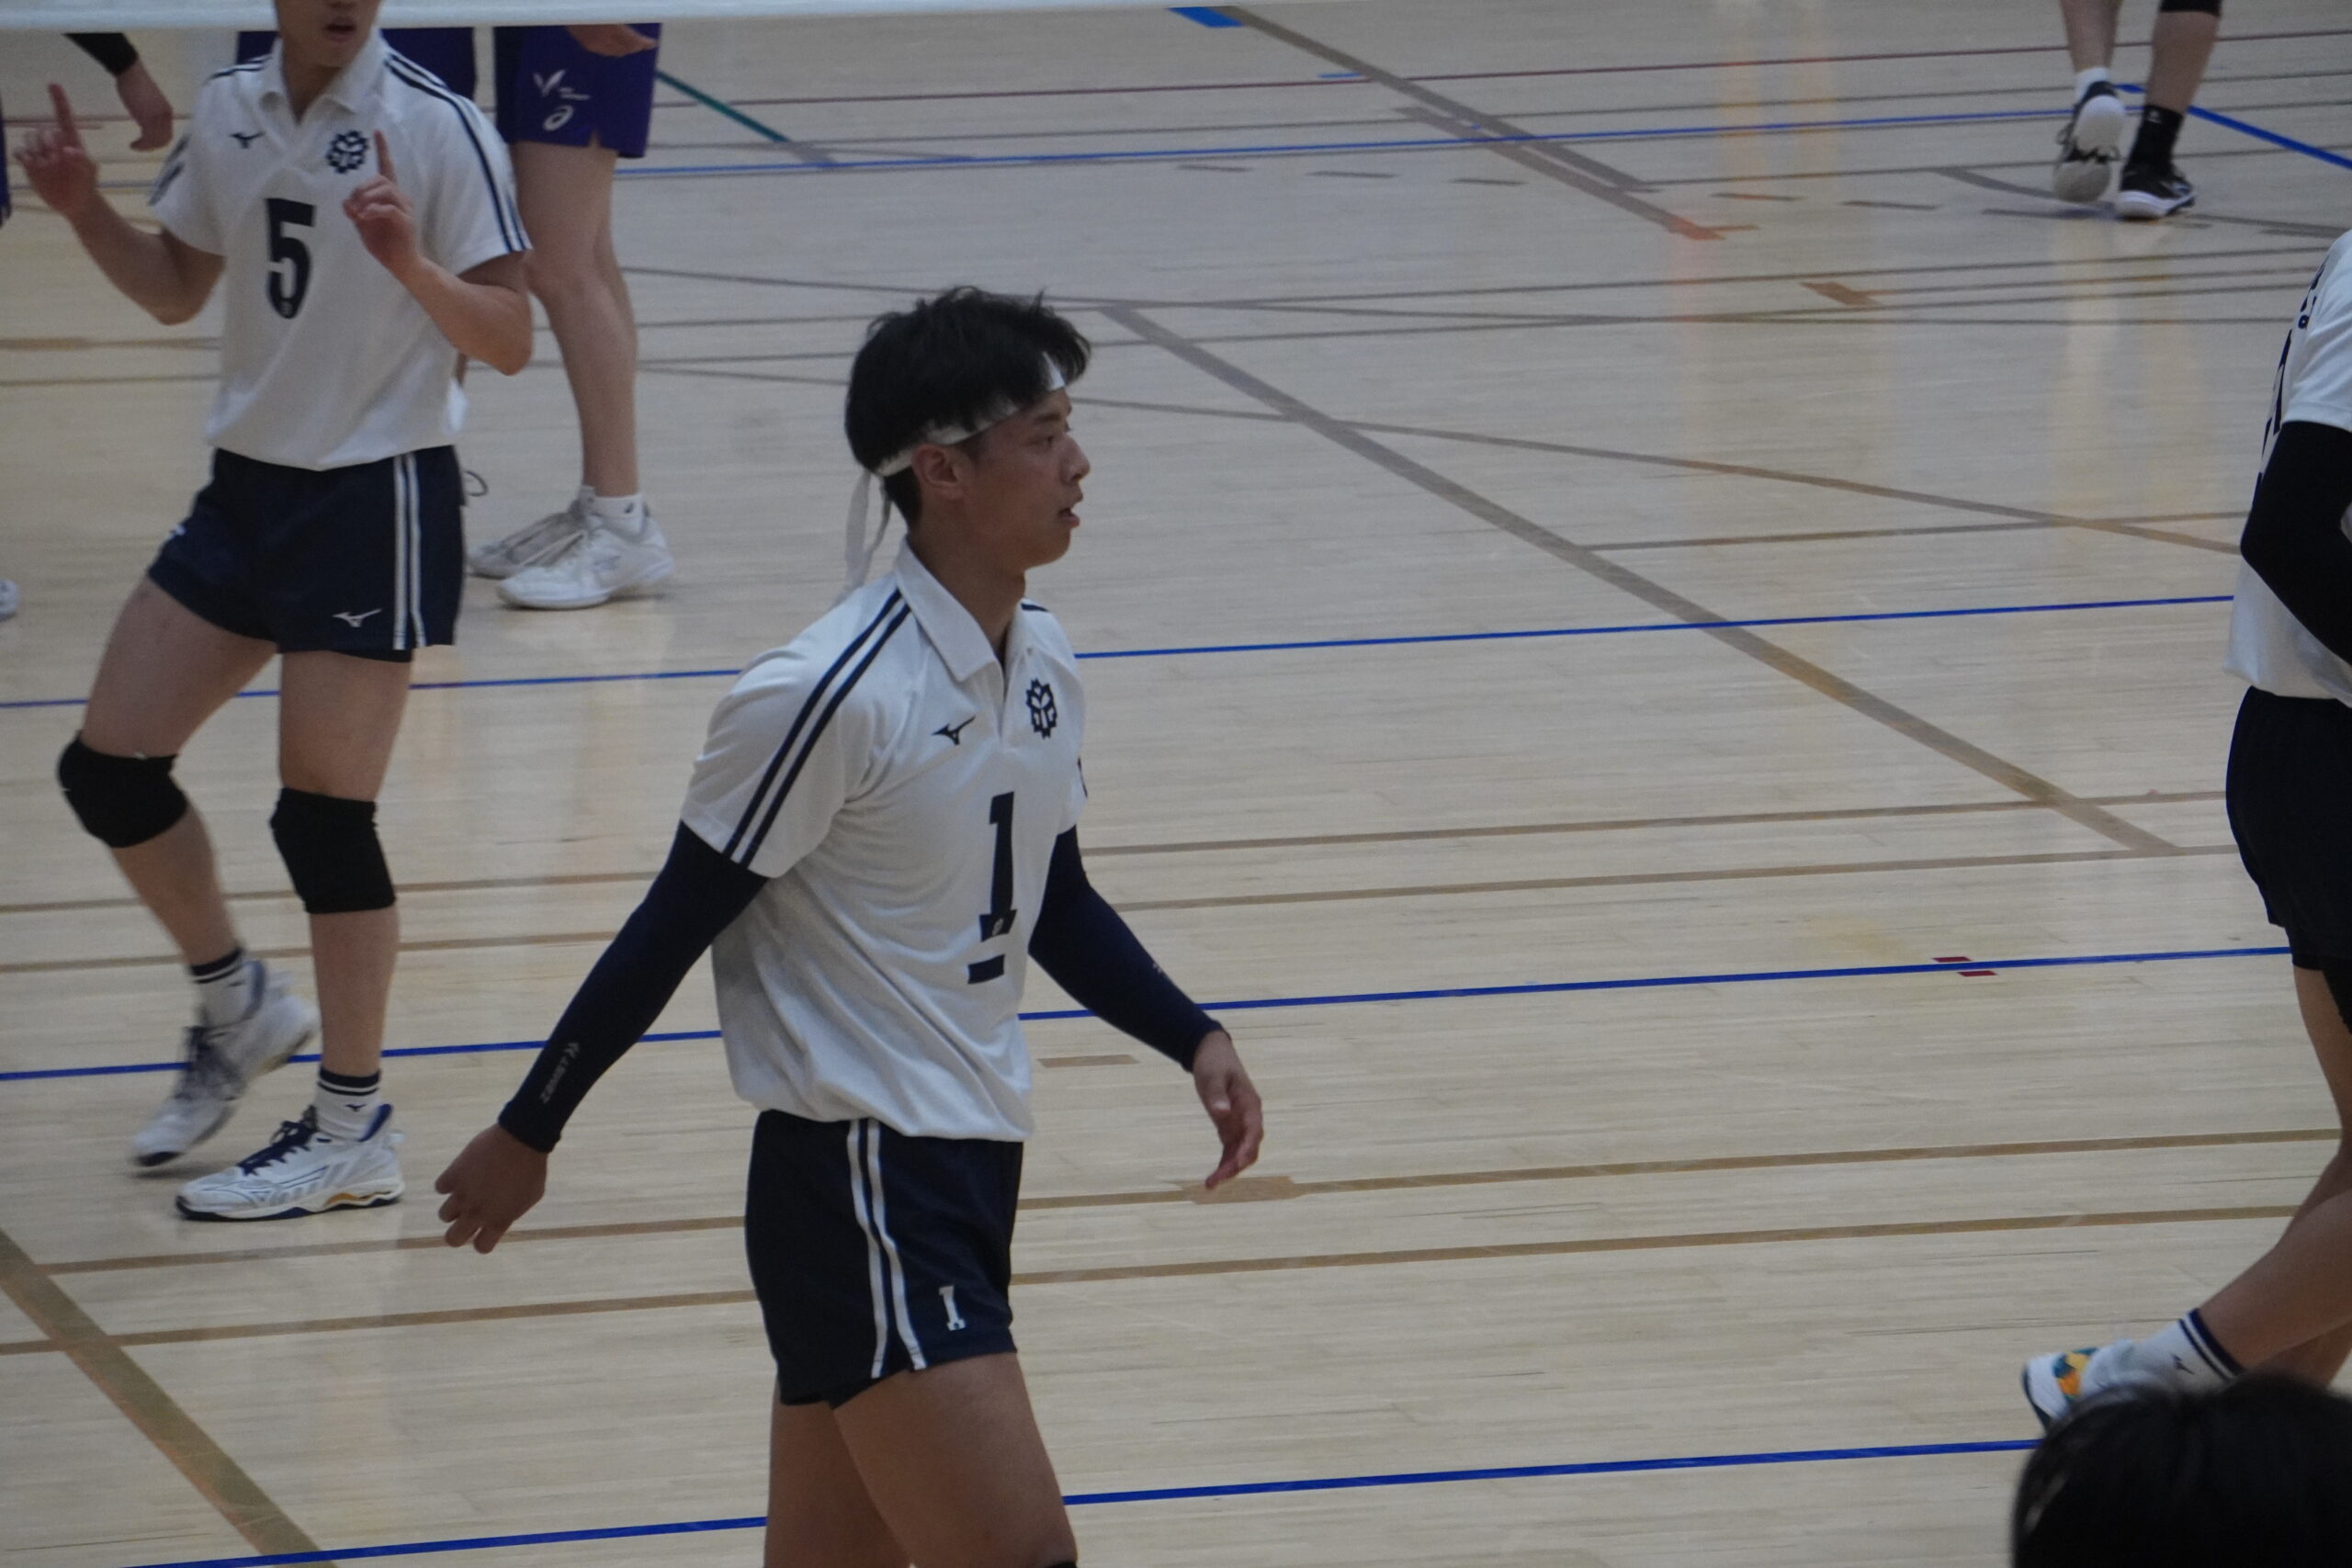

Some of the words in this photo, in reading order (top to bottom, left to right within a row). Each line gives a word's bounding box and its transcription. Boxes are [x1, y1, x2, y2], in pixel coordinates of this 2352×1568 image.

[266, 198, 316, 319] 5
[979, 791, 1017, 942] 1
[939, 1285, 966, 1331] 1
